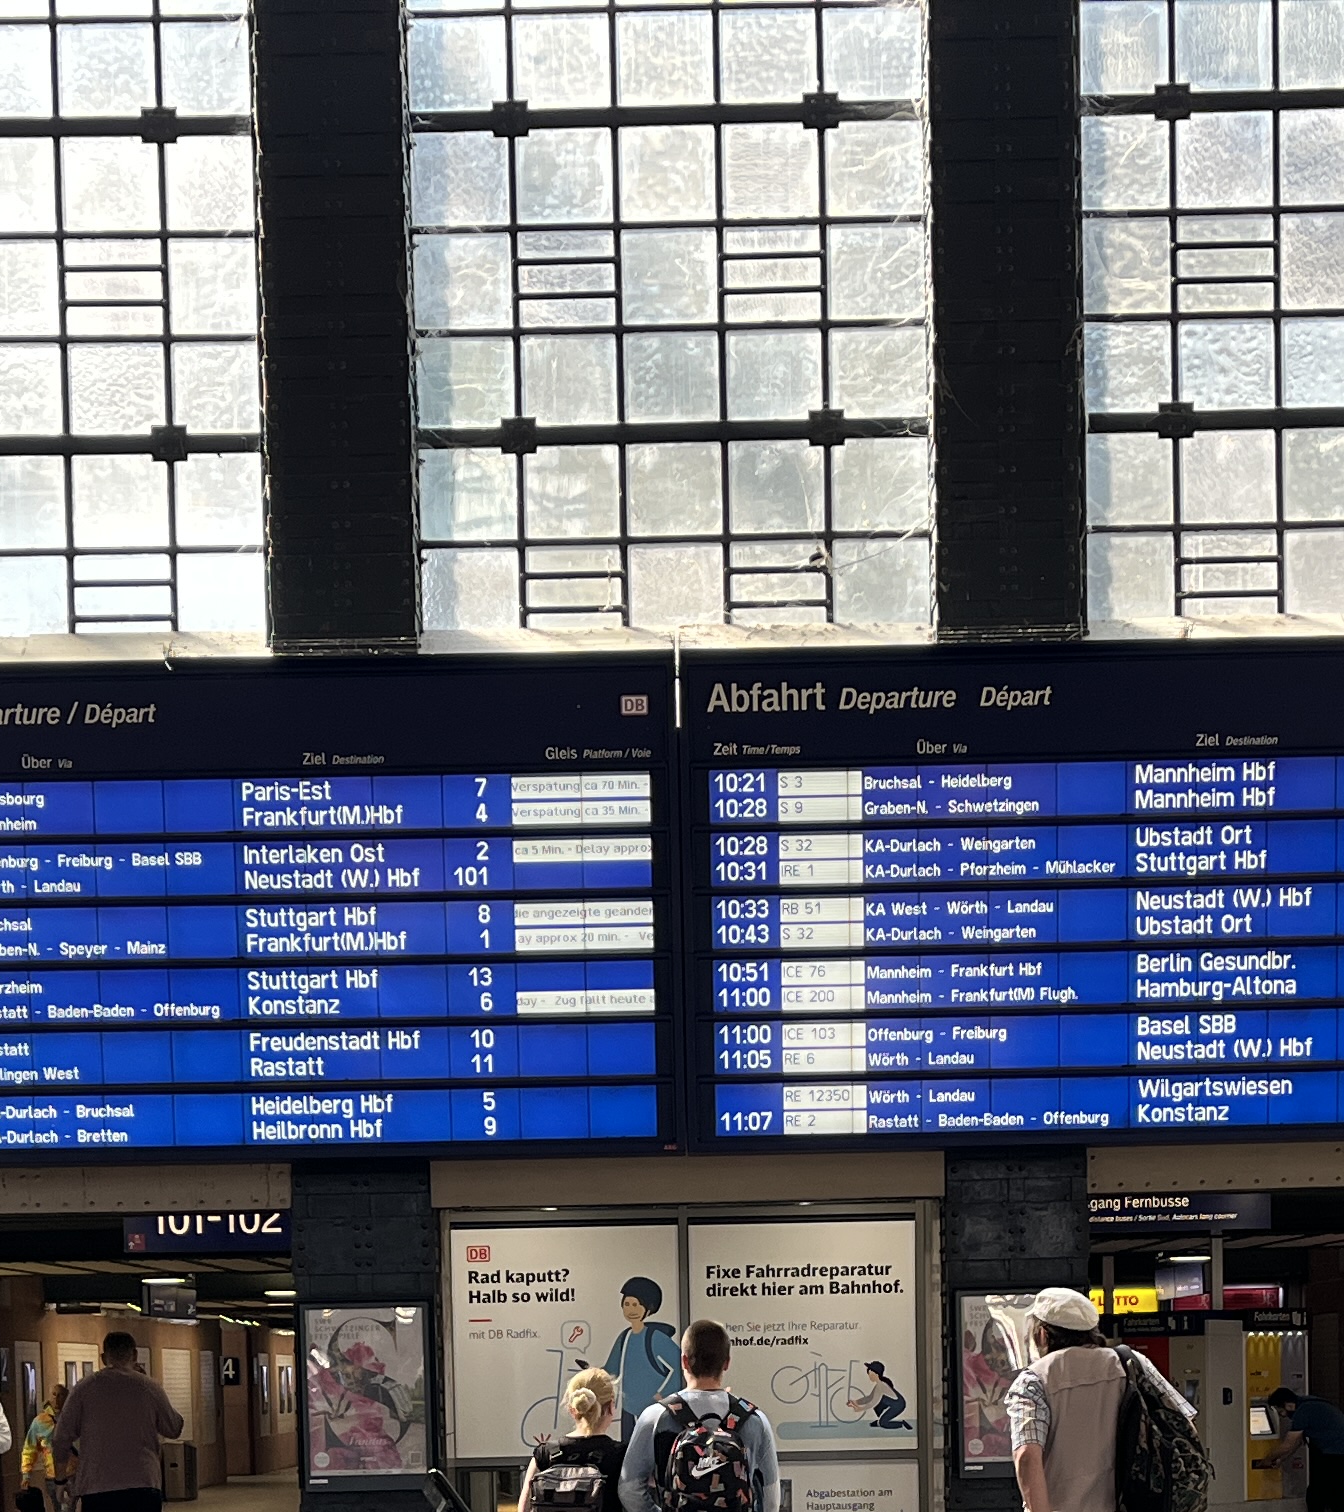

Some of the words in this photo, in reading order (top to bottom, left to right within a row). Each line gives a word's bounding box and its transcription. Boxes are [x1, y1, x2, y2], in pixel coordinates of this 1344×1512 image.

[623, 698, 646, 712] DB
[707, 682, 826, 713] Abfahrt
[838, 686, 957, 714] Departure
[980, 685, 1052, 711] Départ
[67, 701, 78, 725] /
[84, 702, 156, 728] Départ
[713, 743, 738, 756] Zeit
[916, 739, 947, 755] Über
[953, 743, 968, 754] Via
[1196, 734, 1220, 747] Ziel
[1225, 734, 1278, 747] Destination
[21, 754, 52, 770] Über
[57, 757, 73, 769] Via
[302, 752, 326, 766] Ziel
[332, 753, 385, 766] Destination
[545, 746, 577, 760] Gleis
[582, 747, 622, 759] Platform
[631, 747, 651, 758] Voie
[715, 773, 764, 792] 10:21
[1136, 763, 1235, 784] Mannheim
[1243, 761, 1275, 781] Hbf
[242, 781, 331, 801] Paris-Est
[1135, 788, 1234, 809] Mannheim
[1243, 787, 1275, 806] Hbf
[243, 805, 403, 826] Frankfurt(M.)Hbf
[715, 798, 767, 818] 10:28
[716, 836, 768, 856] 10:28
[1136, 826, 1213, 847] Ubstadt
[1221, 825, 1252, 844] Ort
[244, 844, 342, 864] Interlaken
[350, 843, 384, 862] Ost
[1136, 851, 1226, 875] Stuttgart
[1234, 850, 1266, 869] Hbf
[245, 869, 333, 889] Neustadt
[341, 869, 380, 888] (W.)
[388, 868, 419, 888] Hbf
[716, 861, 766, 881] 10:31
[717, 899, 768, 918] 10:33
[1137, 889, 1224, 910] Neustadt
[1233, 888, 1271, 907] (W.)
[1280, 887, 1312, 906] Hbf
[246, 907, 336, 931] Stuttgart
[344, 906, 376, 926] Hbf
[1137, 915, 1213, 935] Ubstadt
[1221, 914, 1252, 934] Ort
[247, 931, 406, 952] Frankfurt(M.)Hbf
[717, 924, 769, 944] 10:43
[718, 962, 768, 982] 10:51
[1137, 953, 1192, 973] Berlin
[1200, 951, 1295, 971] Gesundbr.
[248, 970, 338, 994] Stuttgart
[346, 969, 378, 988] Hbf
[1137, 976, 1296, 1000] Hamburg-Altona
[249, 996, 340, 1015] Konstanz
[719, 988, 770, 1007] 11:00
[719, 1025, 771, 1044] 11:00
[1138, 1015, 1191, 1035] Basel
[1199, 1014, 1236, 1034] SBB
[250, 1031, 380, 1051] Freudenstadt
[388, 1031, 420, 1050] Hbf
[1138, 1040, 1225, 1060] Neustadt
[1234, 1039, 1272, 1058] (W.)
[1280, 1037, 1312, 1056] Hbf
[251, 1057, 324, 1076] Rastatt
[720, 1050, 771, 1069] 11:05
[1139, 1077, 1292, 1102] Wilgartswiesen
[252, 1096, 353, 1118] Heidelberg
[361, 1094, 393, 1113] Hbf
[1138, 1103, 1229, 1122] Konstanz
[253, 1121, 342, 1139] Heilbronn
[350, 1119, 382, 1138] Hbf
[721, 1111, 772, 1131] 11:07
[1088, 1197, 1121, 1212] gang
[1124, 1195, 1190, 1209] Fernbusse
[469, 1248, 488, 1260] DB
[467, 1270, 501, 1284] Rad
[505, 1268, 570, 1286] kaputt?
[705, 1264, 741, 1279] Fixe
[745, 1263, 892, 1281] Fahrradreparatur
[468, 1289, 506, 1304] Halb
[512, 1291, 531, 1303] so
[535, 1288, 576, 1302] wild!
[705, 1282, 758, 1297] direkt
[761, 1281, 795, 1296] hier
[799, 1284, 824, 1296] am
[829, 1279, 904, 1295] Bahnhof.
[1098, 1295, 1139, 1306] LTTO
[469, 1330, 485, 1340] mit
[488, 1329, 504, 1339] DB
[746, 1321, 762, 1332] Sie
[763, 1321, 785, 1334] jetzt
[787, 1320, 807, 1331] Ihre
[223, 1358, 235, 1379] 4
[698, 1456, 720, 1469] NIKE
[805, 1488, 875, 1500] Abgabestation
[878, 1489, 893, 1497] am
[806, 1501, 875, 1512] Hauptausgang
